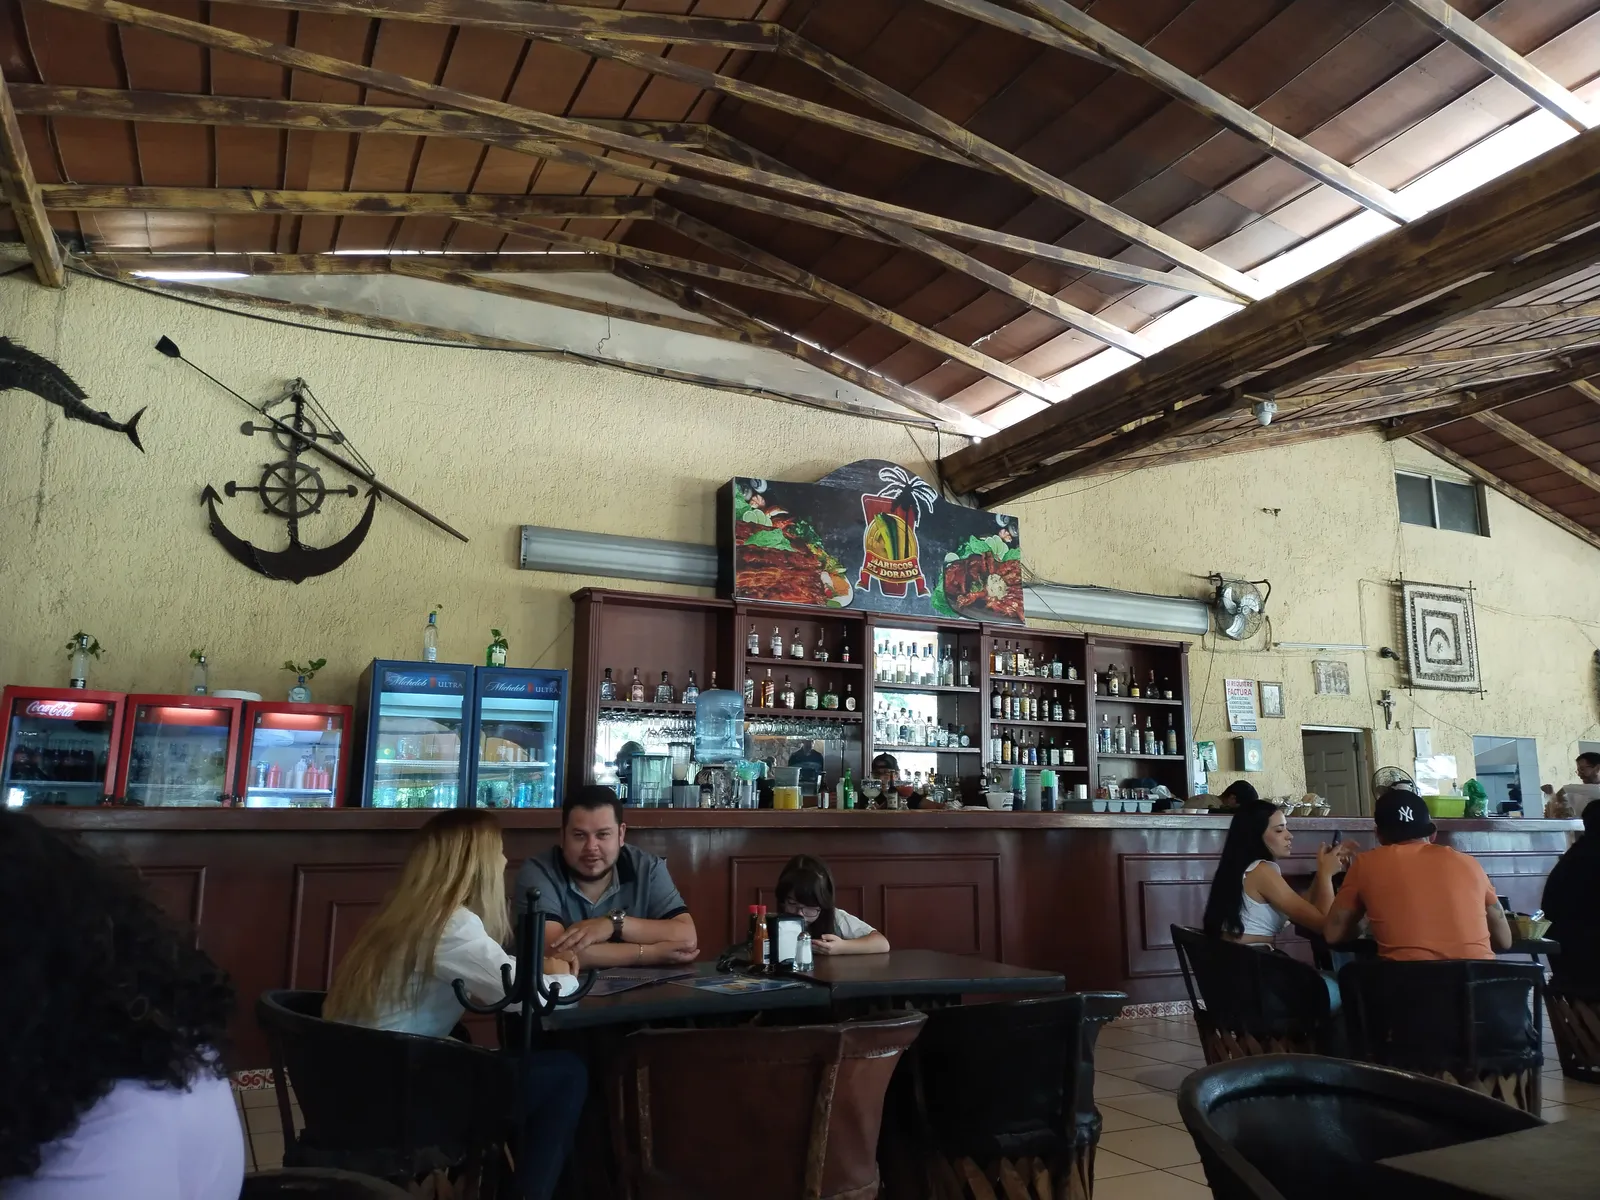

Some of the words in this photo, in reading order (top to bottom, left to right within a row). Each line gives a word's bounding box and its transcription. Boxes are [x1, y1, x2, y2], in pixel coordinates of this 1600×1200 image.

[866, 562, 878, 574] EL
[880, 569, 919, 578] DORADO
[871, 556, 913, 570] MARISCOS
[390, 674, 428, 687] Michelob
[438, 681, 463, 689] ULTRA
[485, 681, 525, 692] Michelob
[535, 686, 559, 694] ULTRA
[1227, 688, 1253, 696] FACTURA
